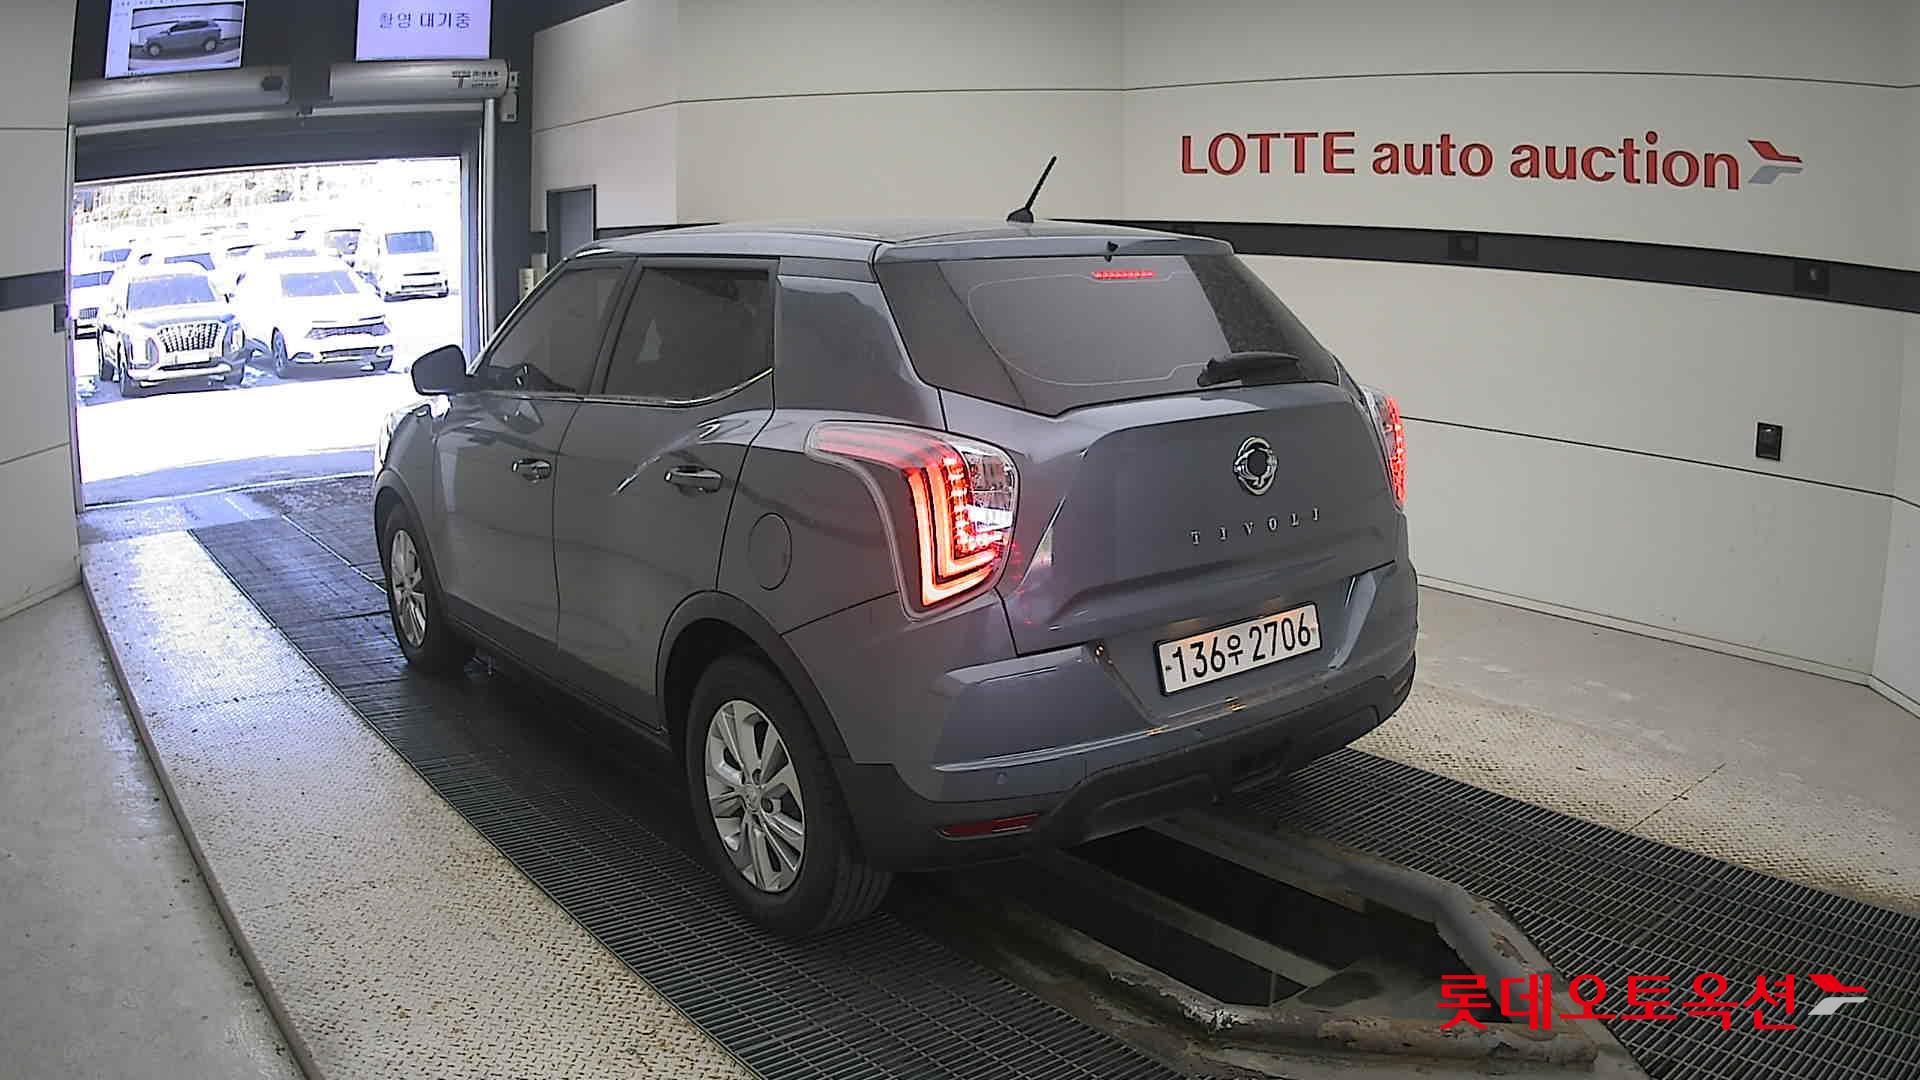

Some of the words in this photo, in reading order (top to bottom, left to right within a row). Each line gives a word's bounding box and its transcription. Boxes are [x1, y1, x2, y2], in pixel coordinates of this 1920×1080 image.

[420, 12, 471, 29] 대기중
[1181, 131, 1356, 176] LOTTE
[1371, 133, 1494, 177] auto
[1509, 130, 1741, 191] auction
[1190, 507, 1321, 545] TIVOLI
[1172, 634, 1244, 683] 136우
[1249, 612, 1312, 663] 2706
